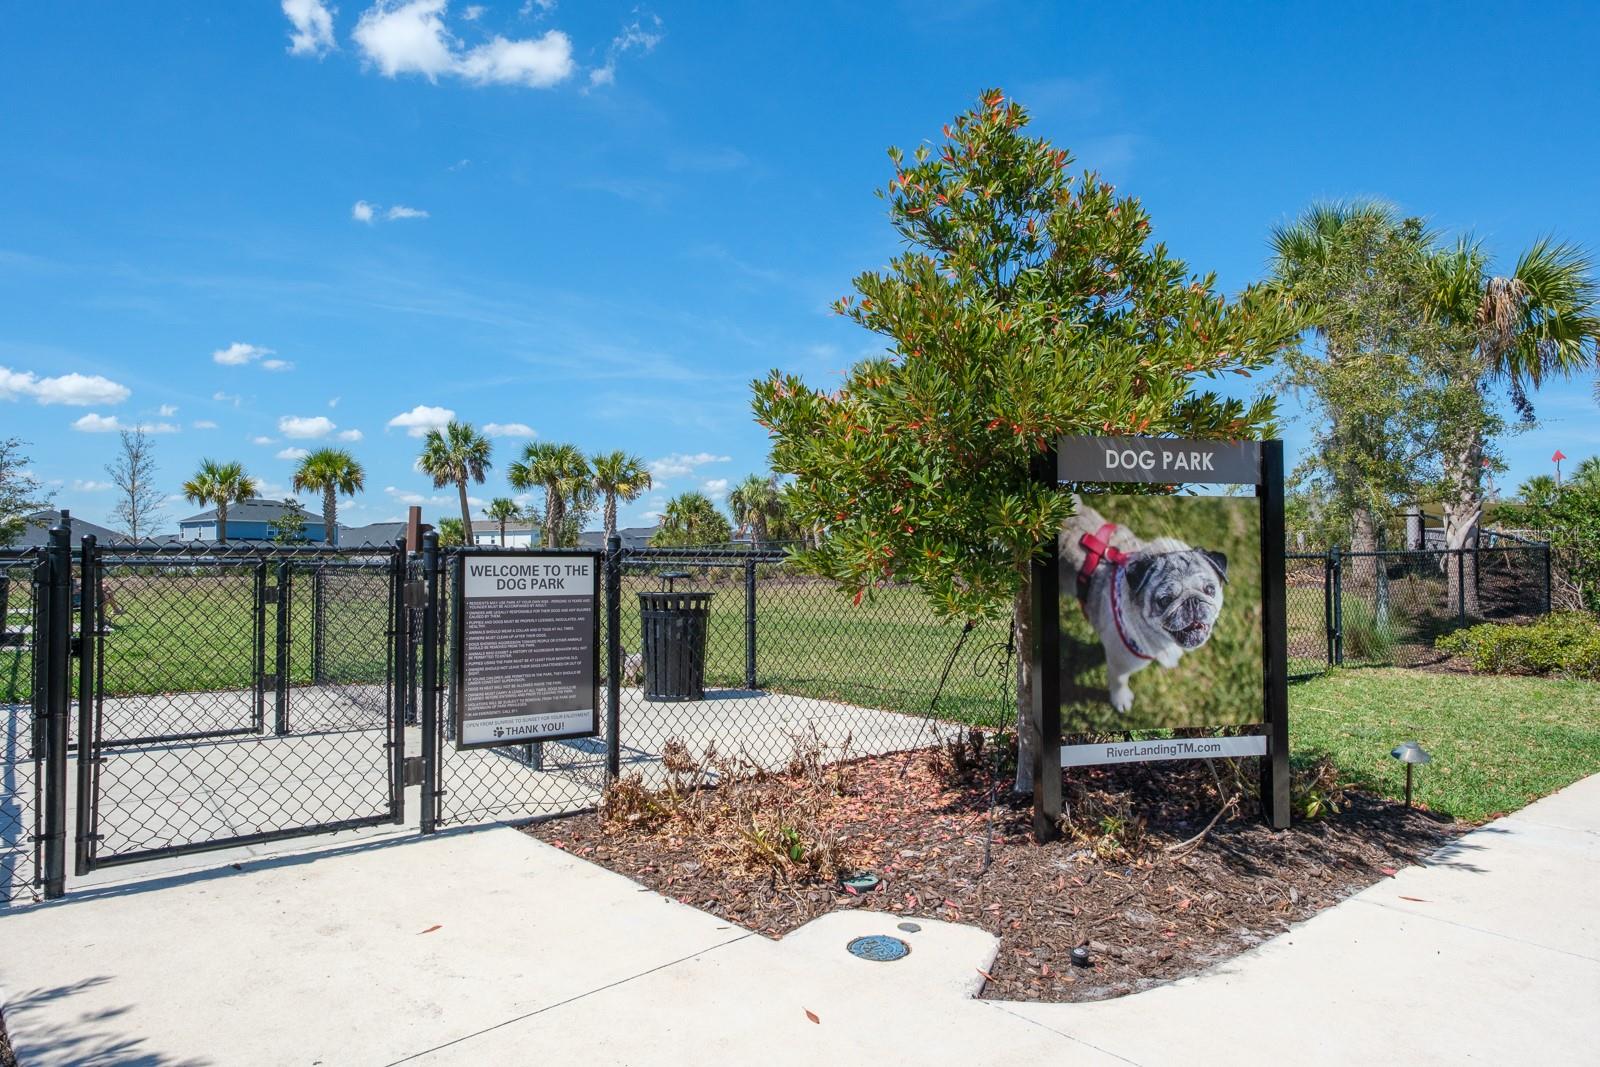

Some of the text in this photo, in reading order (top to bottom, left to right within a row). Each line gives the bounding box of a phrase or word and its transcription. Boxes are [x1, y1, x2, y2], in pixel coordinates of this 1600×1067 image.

[1105, 449, 1214, 471] DOG PARK
[470, 565, 589, 576] WELCOME TO THE
[496, 578, 564, 590] DOG PARK
[506, 722, 564, 736] THANK YOU!
[1106, 742, 1221, 758] RiverLandingTM.com
